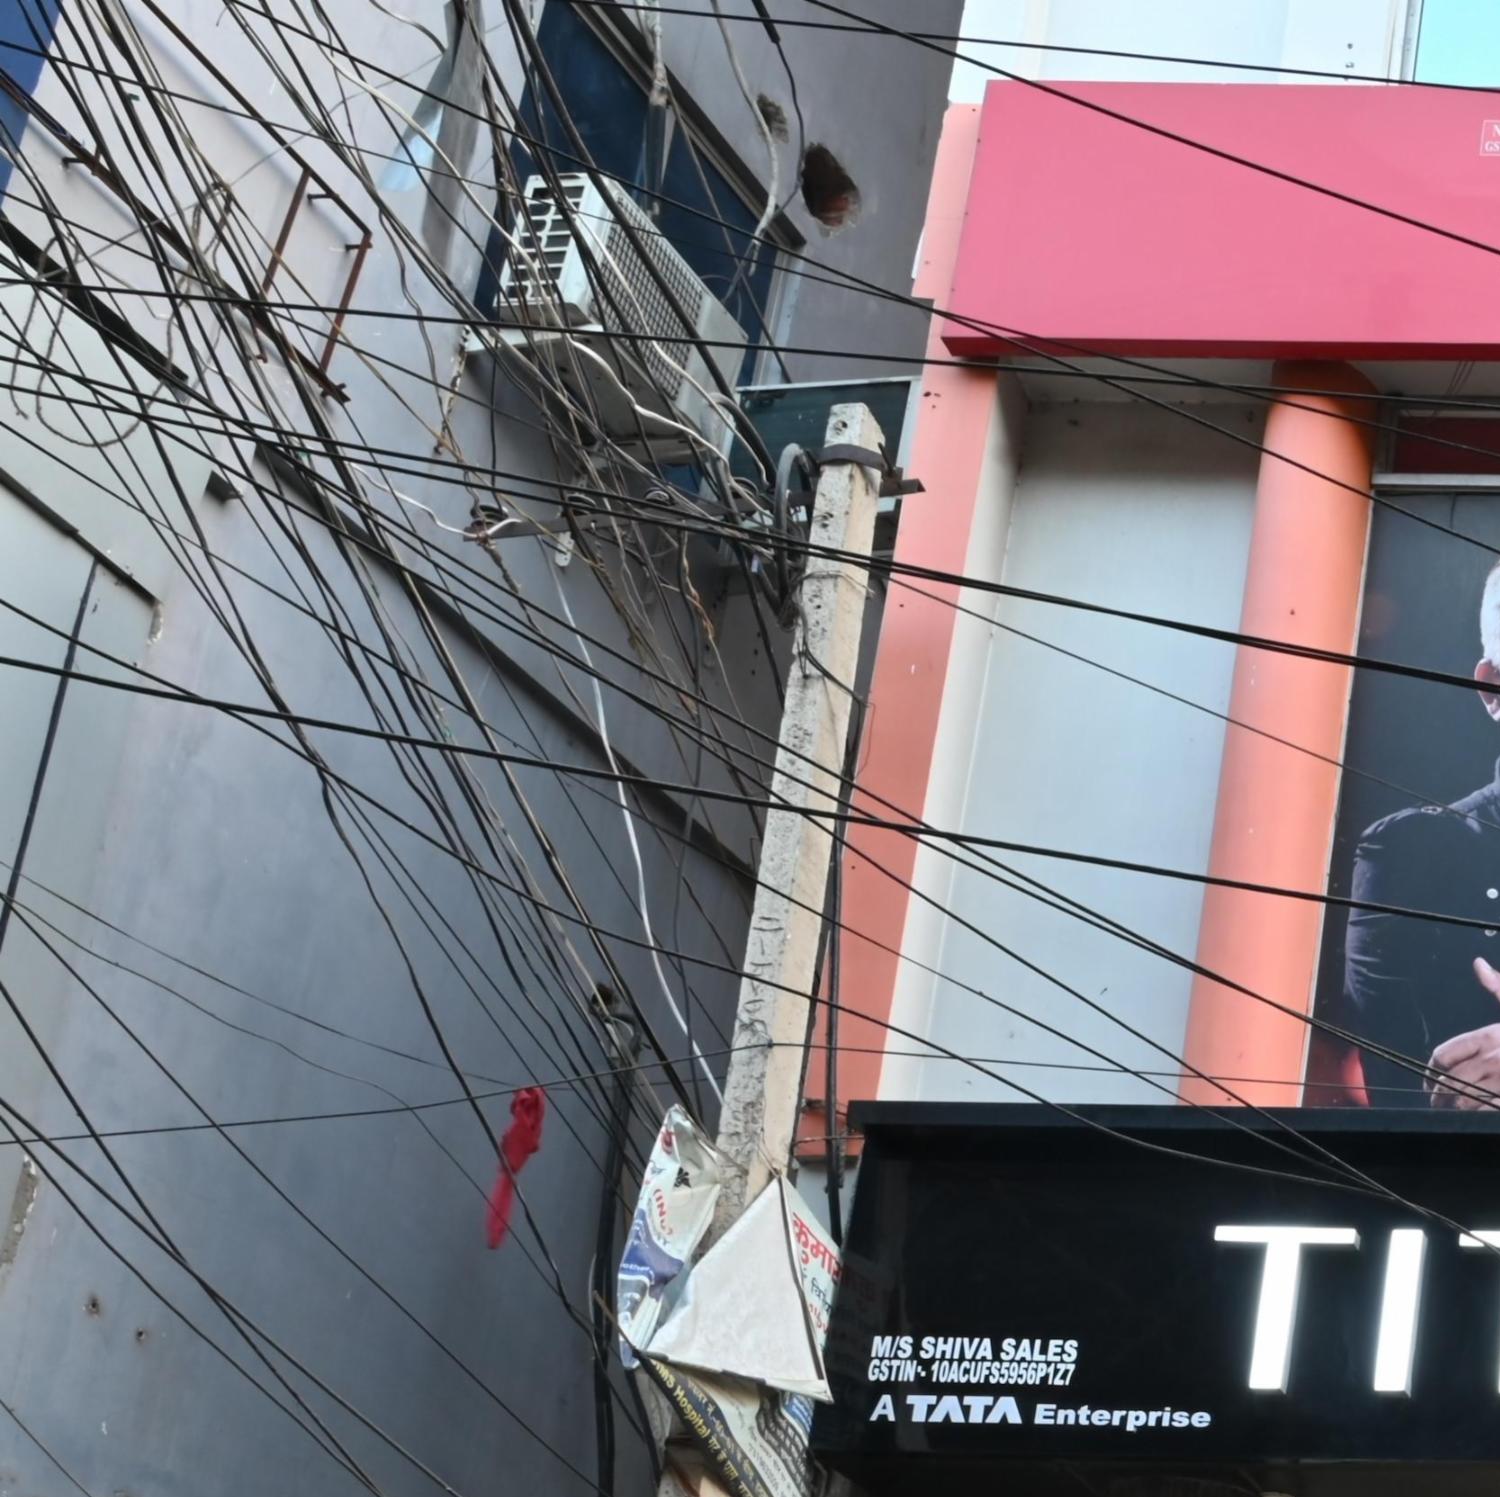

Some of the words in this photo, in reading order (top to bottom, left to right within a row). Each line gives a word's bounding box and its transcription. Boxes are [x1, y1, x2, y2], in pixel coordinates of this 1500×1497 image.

[871, 1335, 913, 1360] M/S
[920, 1336, 993, 1362] SHIVA
[999, 1338, 1079, 1364] SALES
[670, 1387, 711, 1441] Hospital
[869, 1394, 897, 1423] A
[905, 1394, 1023, 1425] TATA
[1034, 1402, 1212, 1433] Enterprise
